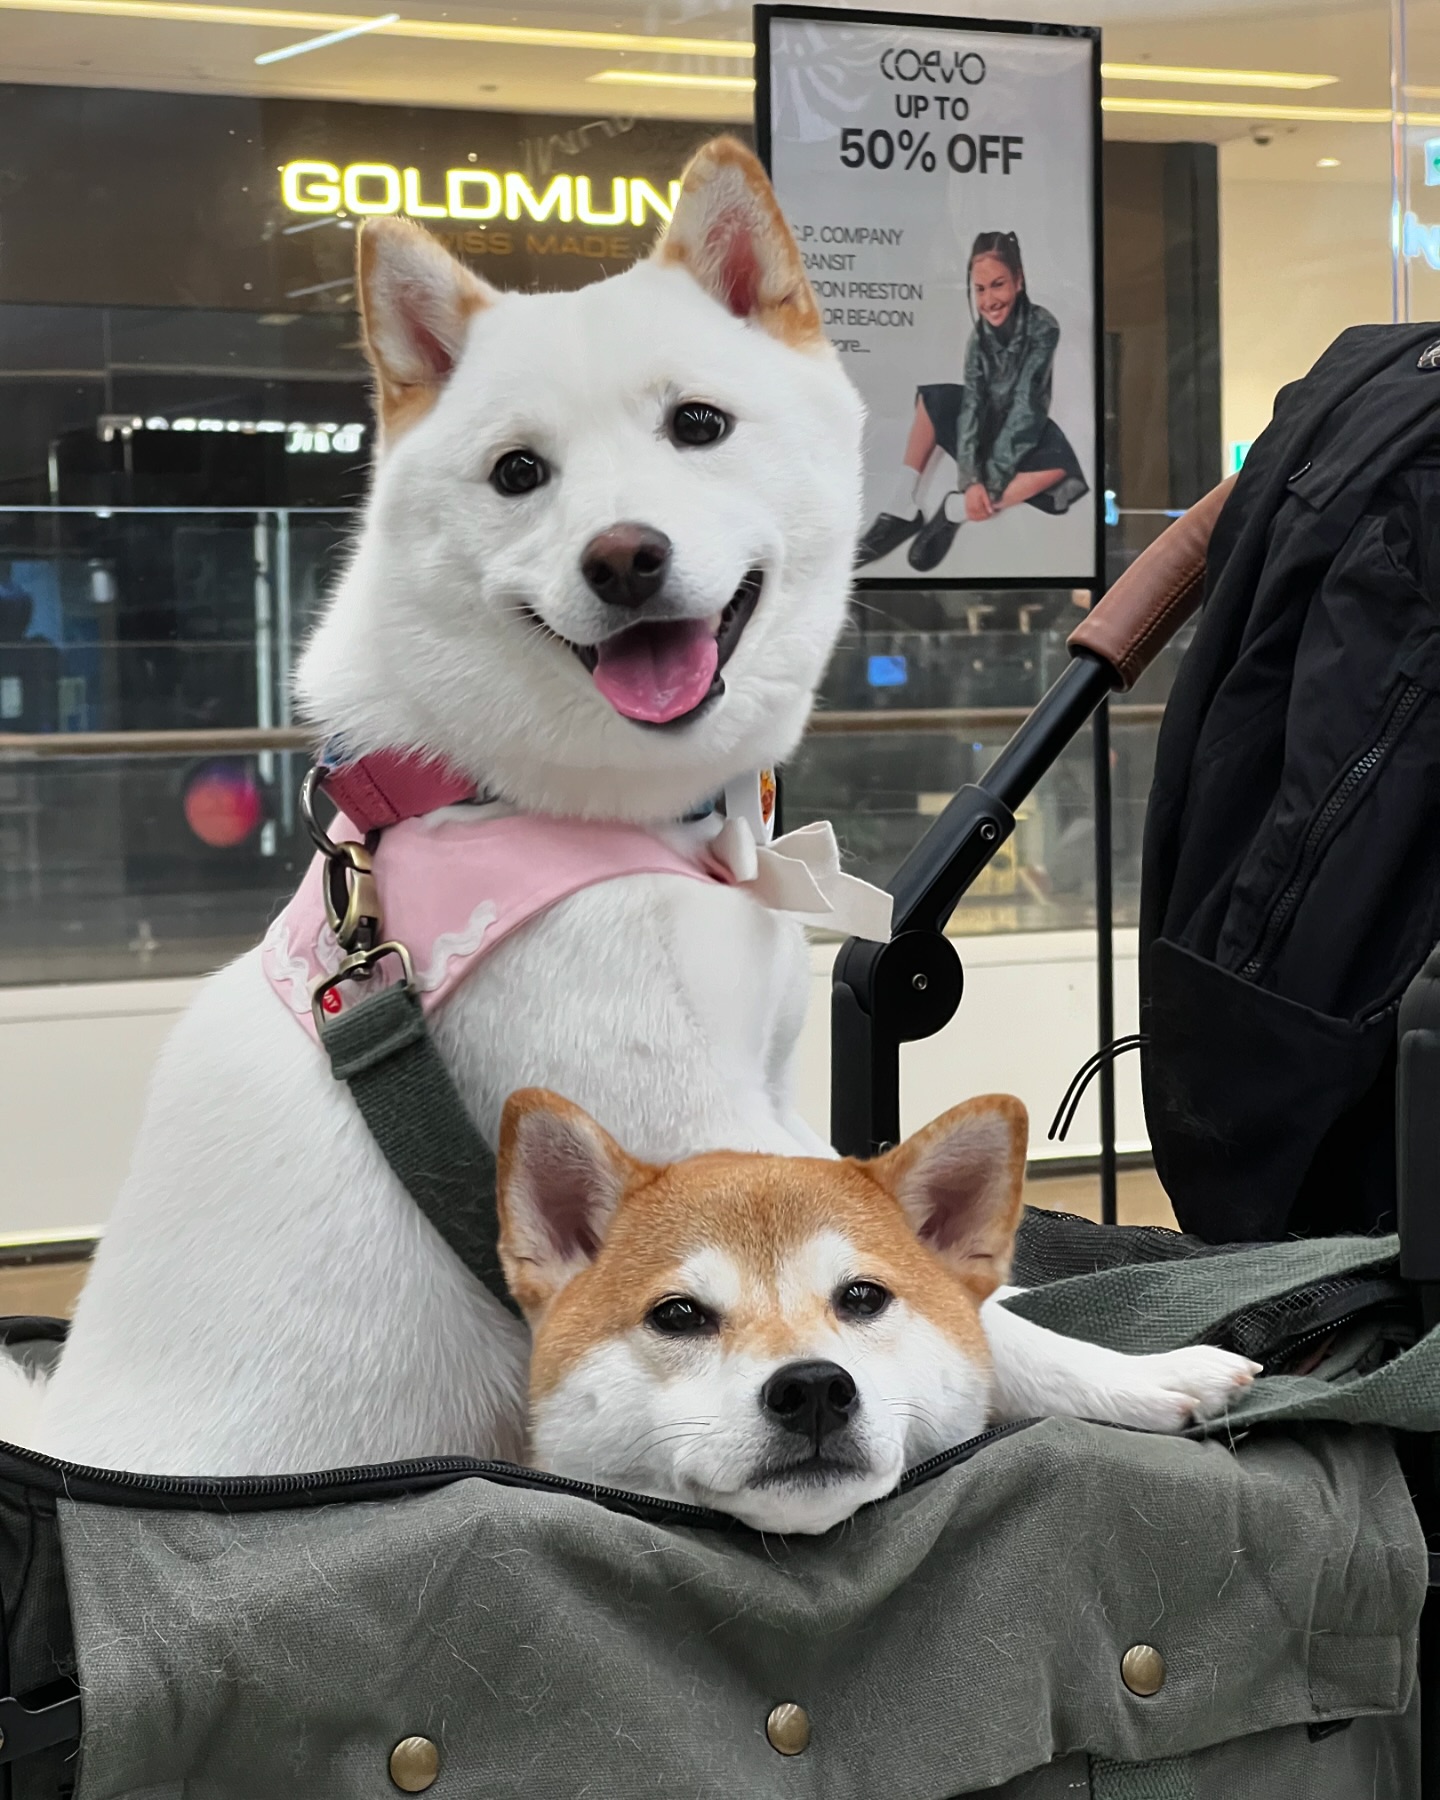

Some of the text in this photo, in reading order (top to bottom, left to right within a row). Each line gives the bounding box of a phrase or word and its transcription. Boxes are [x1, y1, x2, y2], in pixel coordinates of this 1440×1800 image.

[895, 94, 969, 121] UP TO
[840, 128, 1024, 175] 50% OFF
[526, 233, 634, 259] MADE
[820, 226, 904, 245] COMPANY
[848, 281, 923, 300] PRESTON
[847, 309, 914, 327] BEACON
